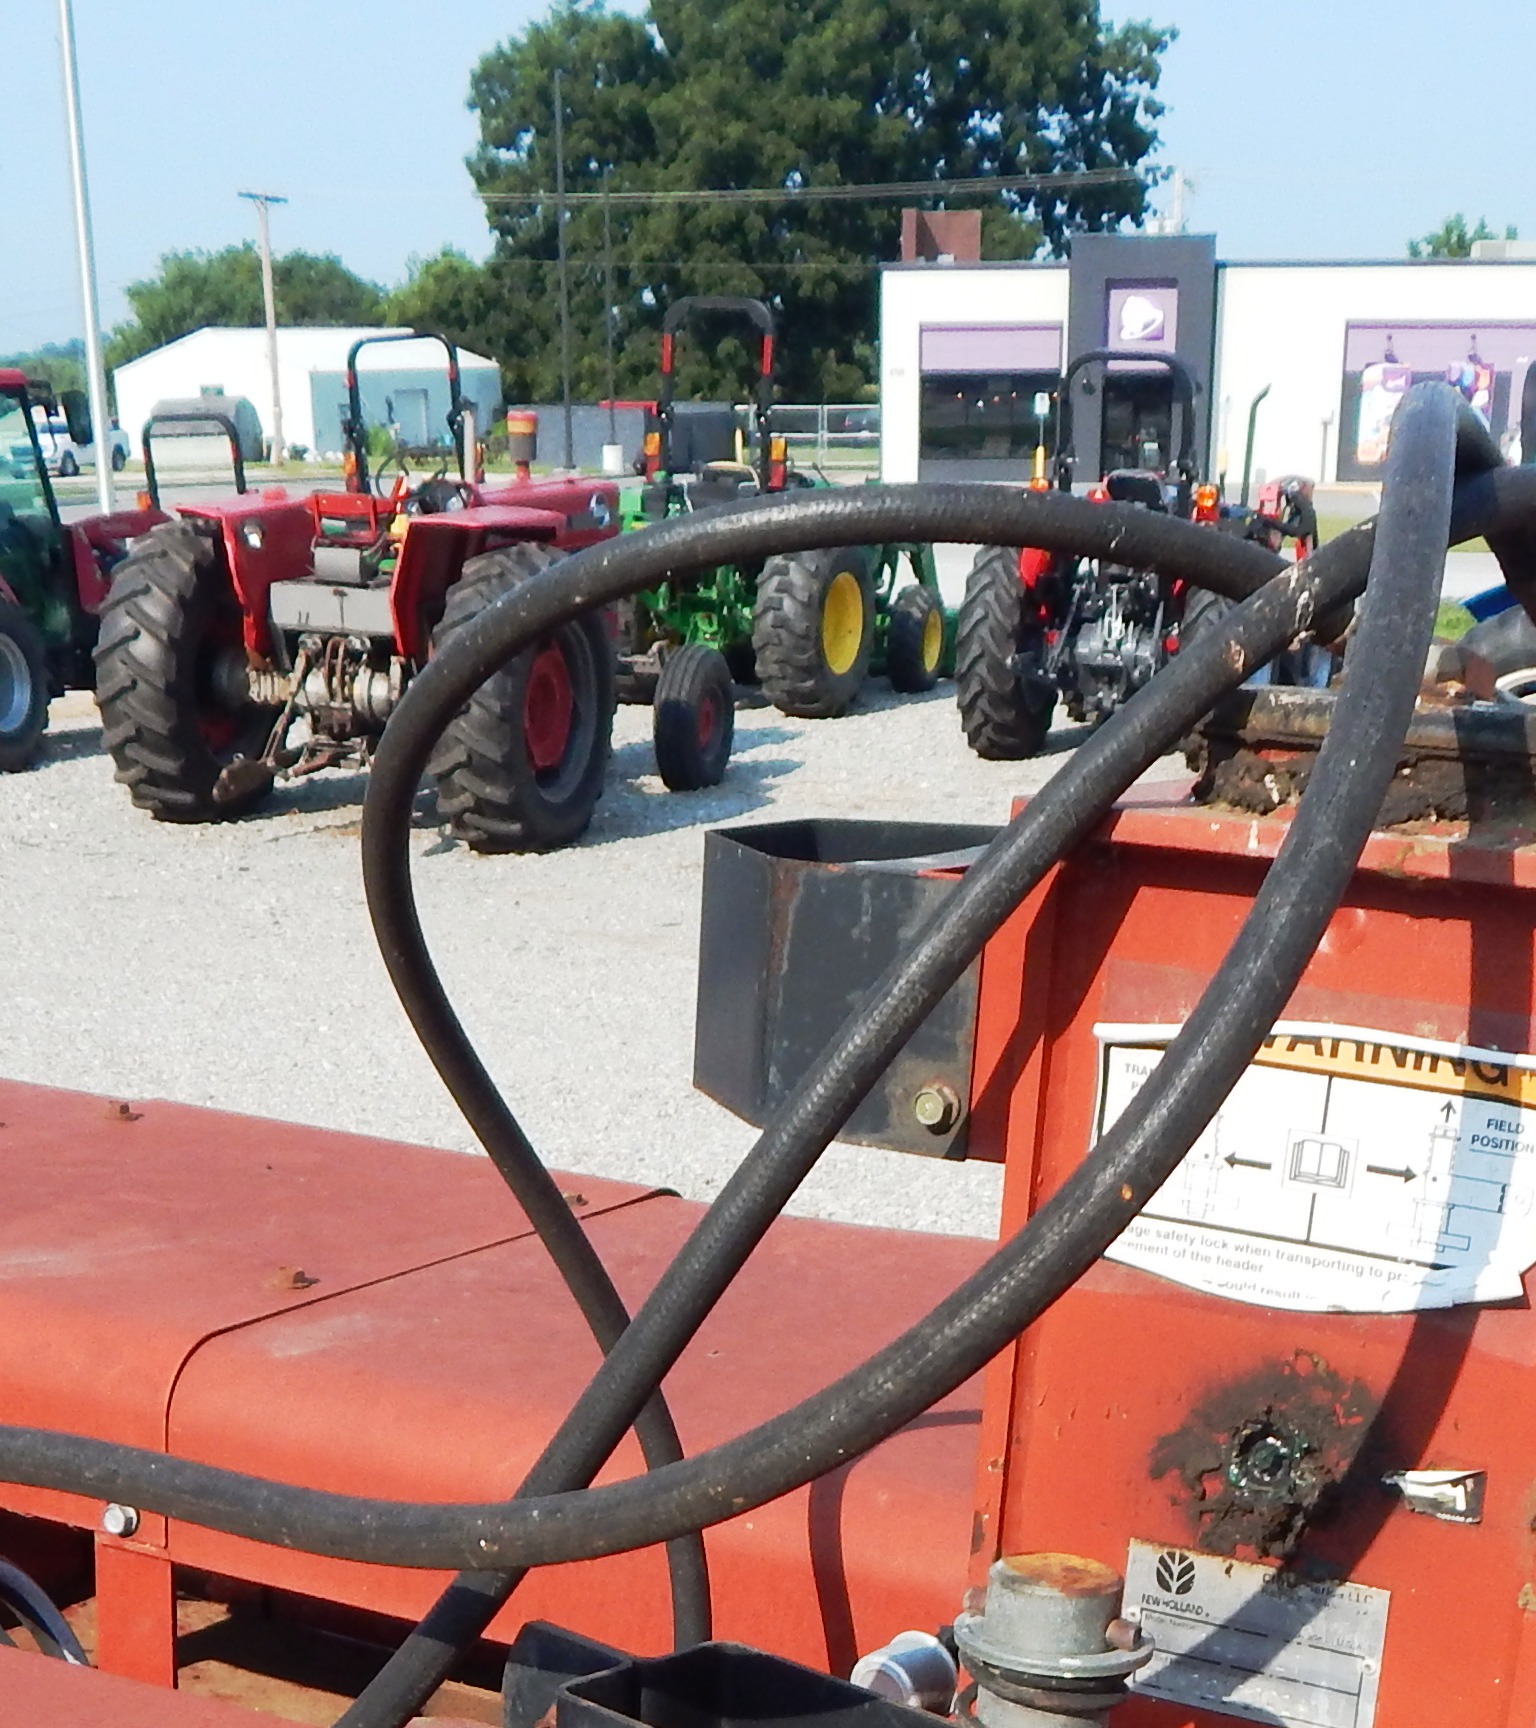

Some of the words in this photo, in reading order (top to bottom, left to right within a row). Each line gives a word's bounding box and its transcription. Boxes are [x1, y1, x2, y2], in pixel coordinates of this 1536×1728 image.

[1486, 1118, 1525, 1134] FIELD
[1470, 1135, 1535, 1154] POSITION
[1126, 1226, 1151, 1238] age
[1156, 1229, 1196, 1246] safety
[1201, 1235, 1229, 1249] lock
[1234, 1243, 1272, 1258] when
[1275, 1249, 1364, 1277] transporting
[1369, 1266, 1383, 1278] to
[1173, 1247, 1187, 1257] of
[1190, 1250, 1212, 1263] the
[1216, 1255, 1264, 1273] header
